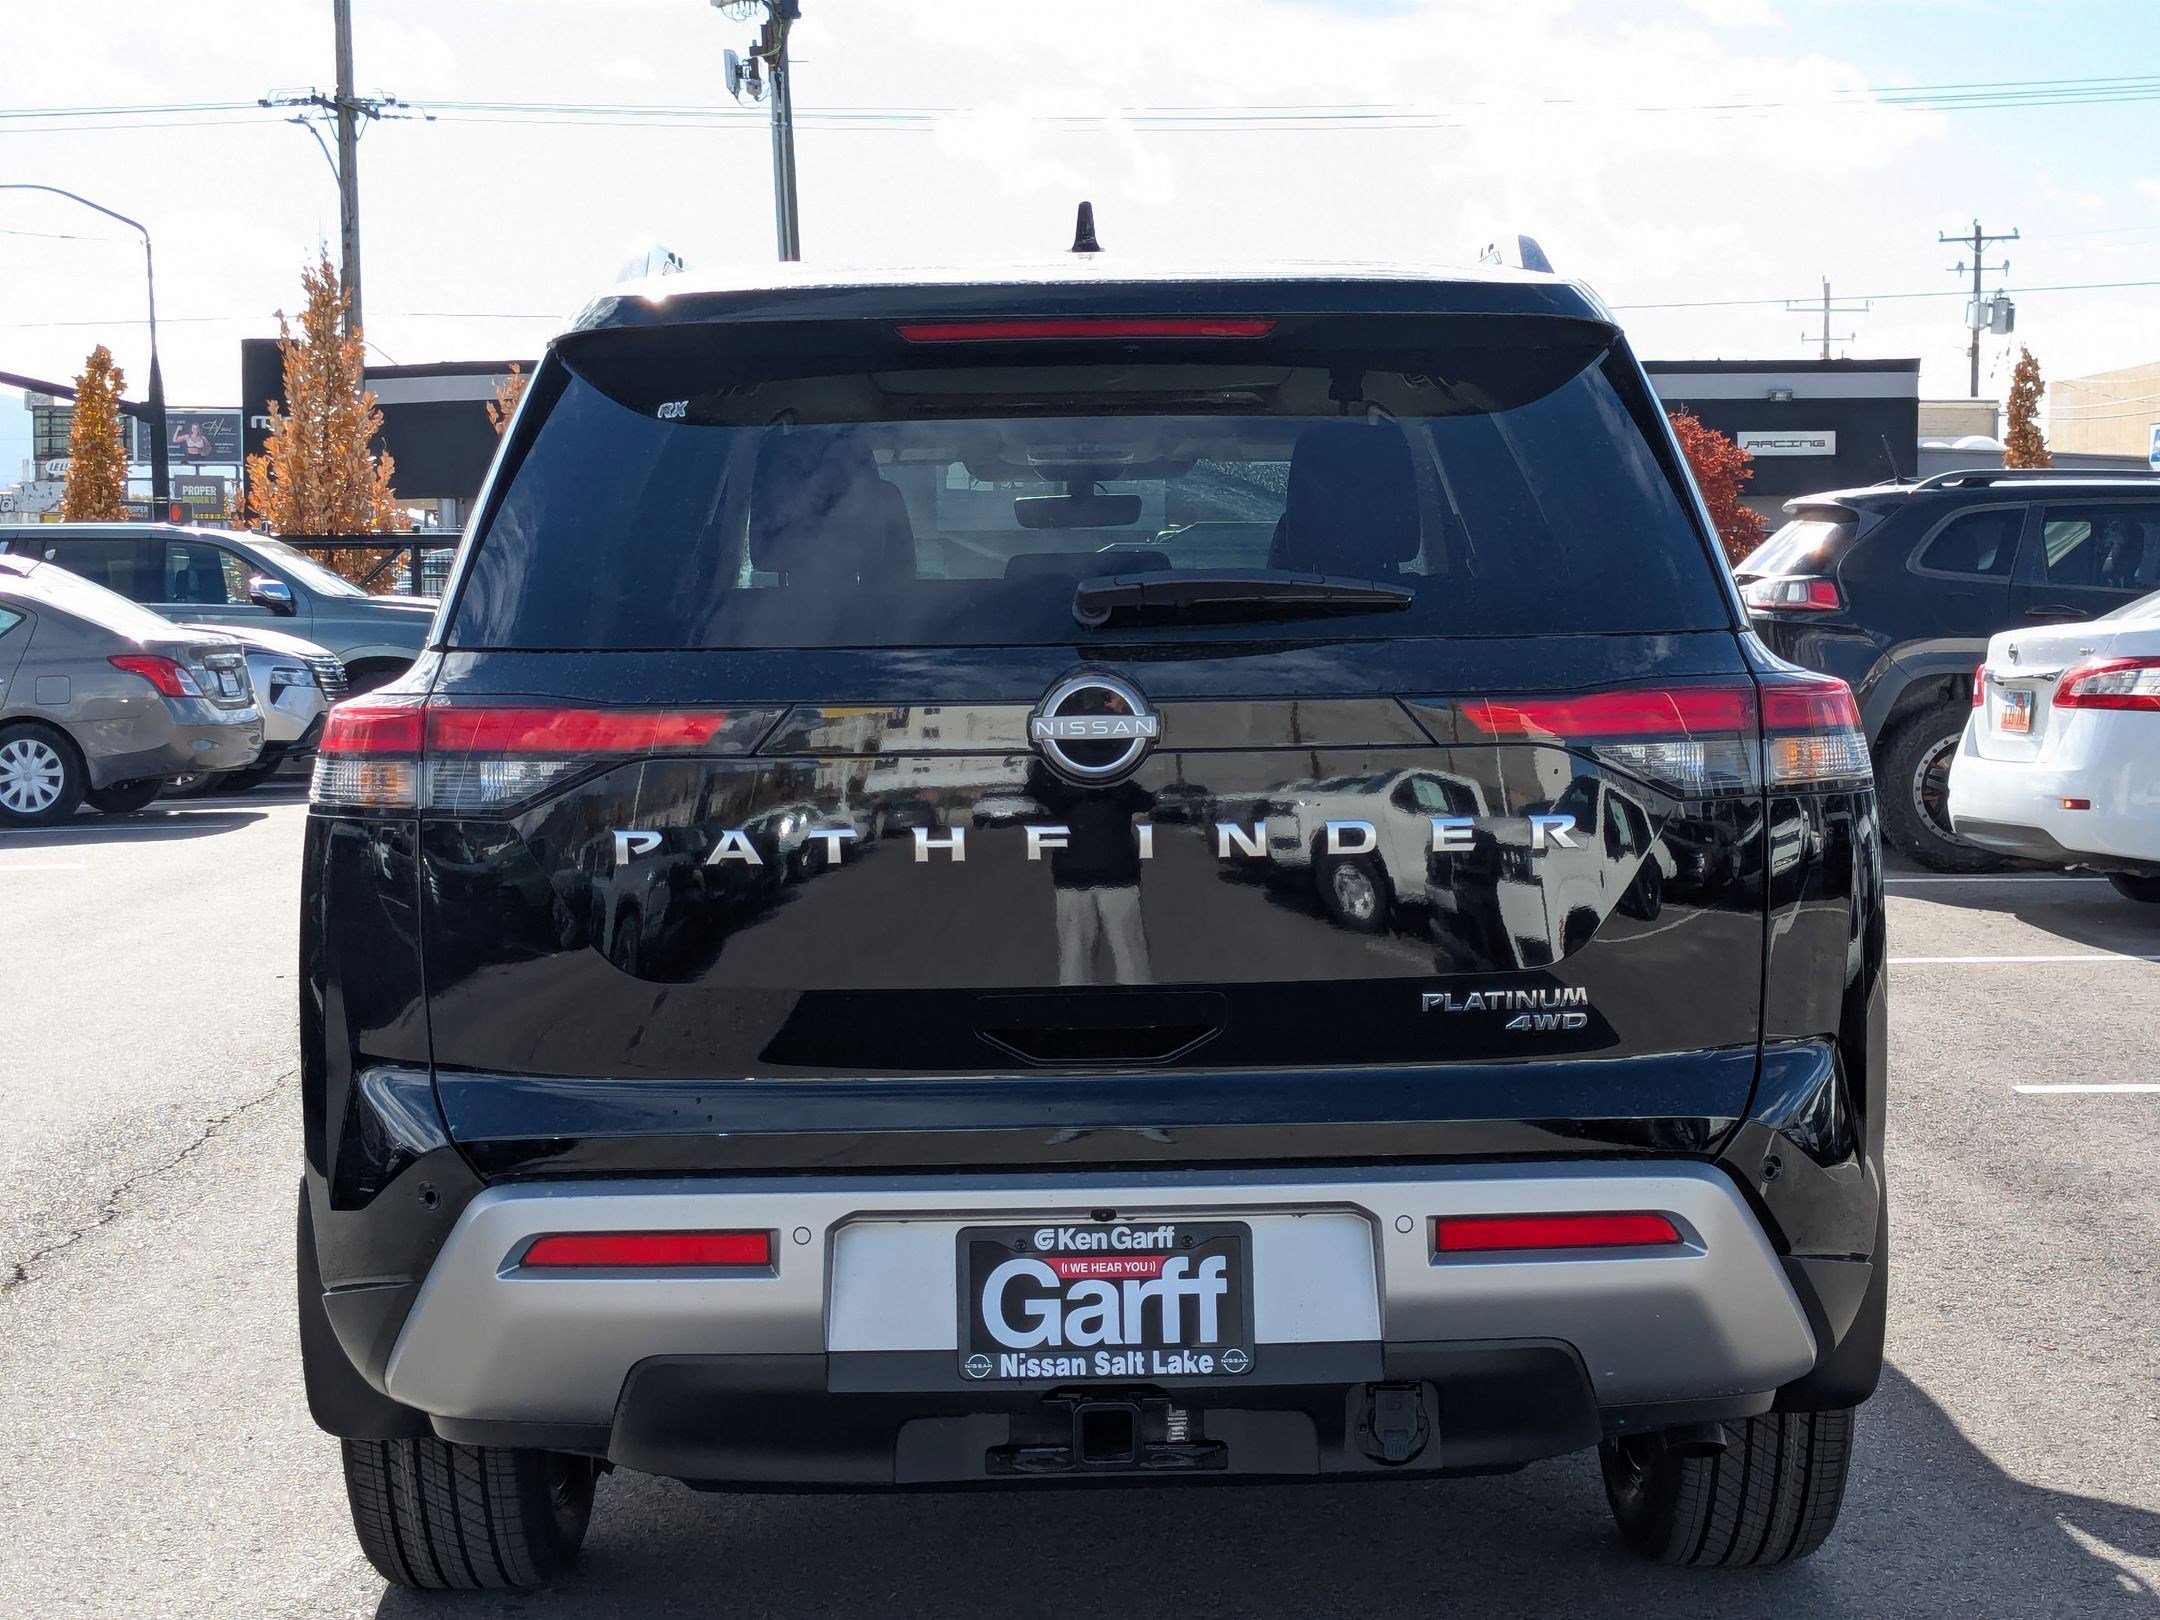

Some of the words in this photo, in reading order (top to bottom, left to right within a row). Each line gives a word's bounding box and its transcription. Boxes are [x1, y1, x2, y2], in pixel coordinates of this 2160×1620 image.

[182, 485, 217, 497] PROPER
[1036, 720, 1153, 736] NISSAN
[611, 814, 1582, 866] PATHFINDER
[1422, 986, 1589, 1013] PLATINUM
[1505, 1012, 1588, 1031] 4WD
[1058, 1227, 1109, 1250] Ken
[1111, 1225, 1176, 1249] Garff
[1070, 1263, 1089, 1273] WE
[1091, 1262, 1122, 1273] HEAR
[1124, 1261, 1148, 1272] YOU
[982, 1255, 1228, 1349] Garff
[1001, 1352, 1087, 1378] Nissan
[1094, 1350, 1145, 1376] Salt
[1153, 1350, 1215, 1375] Lake
